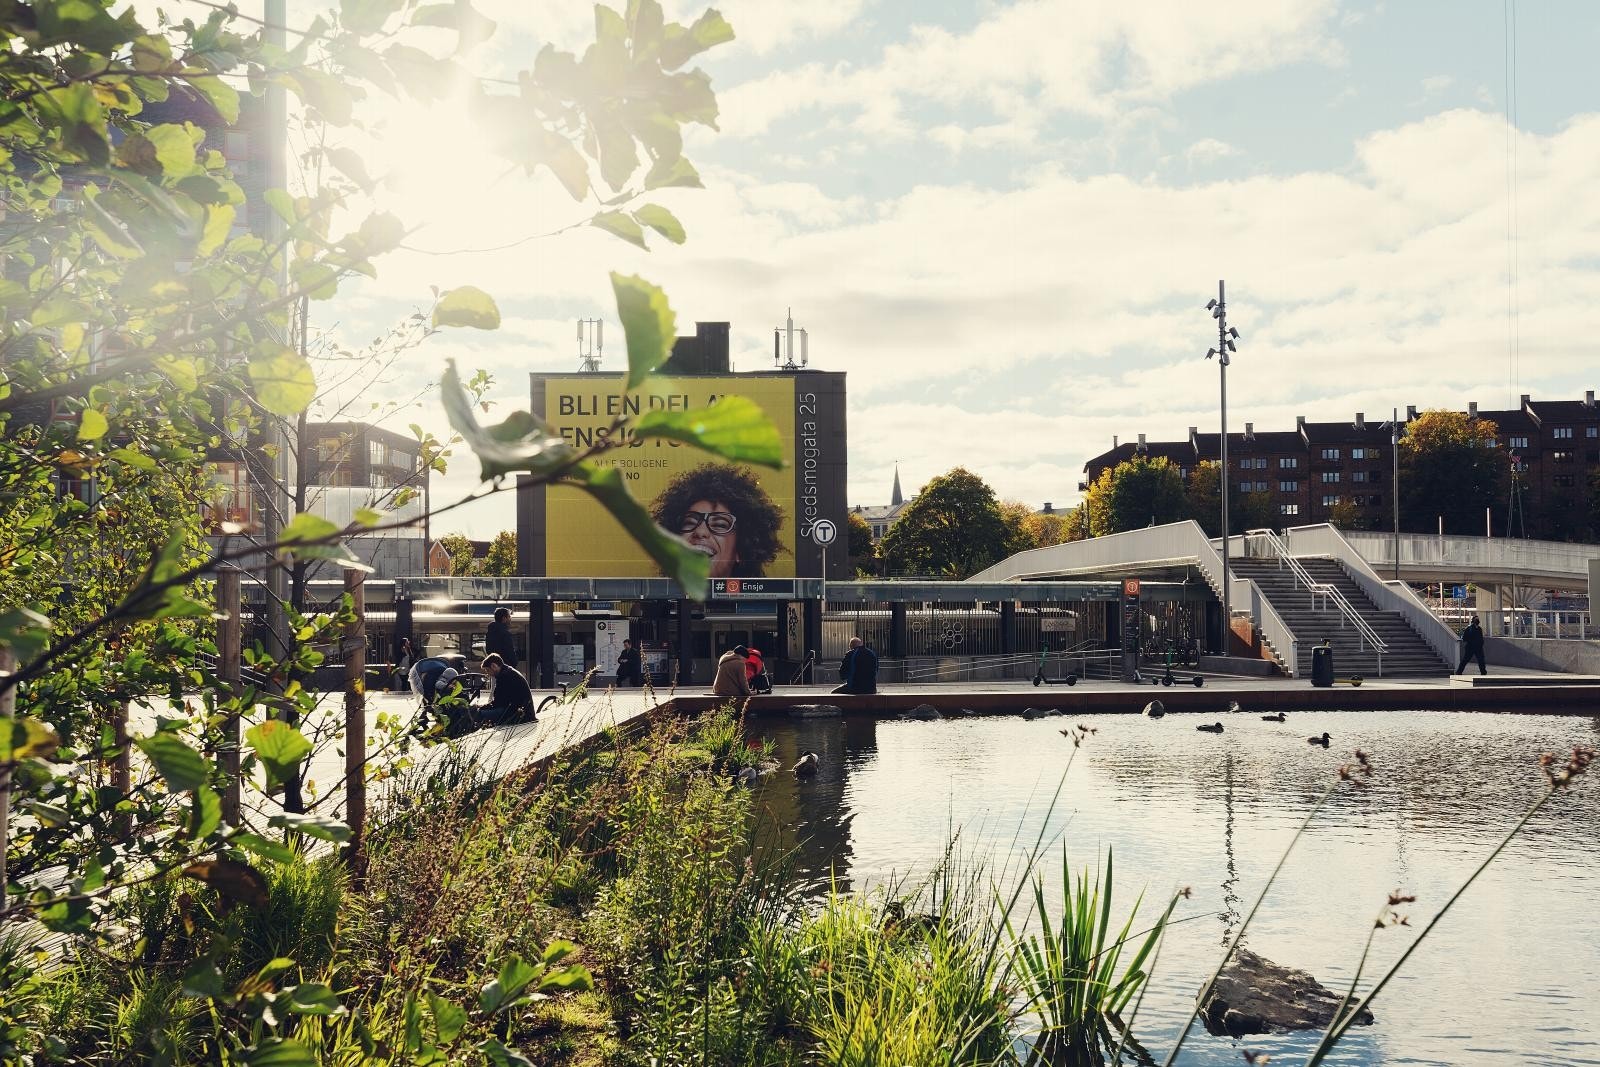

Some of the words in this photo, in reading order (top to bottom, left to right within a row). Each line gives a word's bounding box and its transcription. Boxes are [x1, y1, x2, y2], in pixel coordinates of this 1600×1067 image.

[559, 394, 598, 416] BLI
[606, 394, 640, 416] EN
[799, 392, 816, 415] 25
[619, 459, 668, 468] BOLIGENE
[800, 421, 820, 537] Skedsmogata
[742, 582, 764, 592] Ensjø
